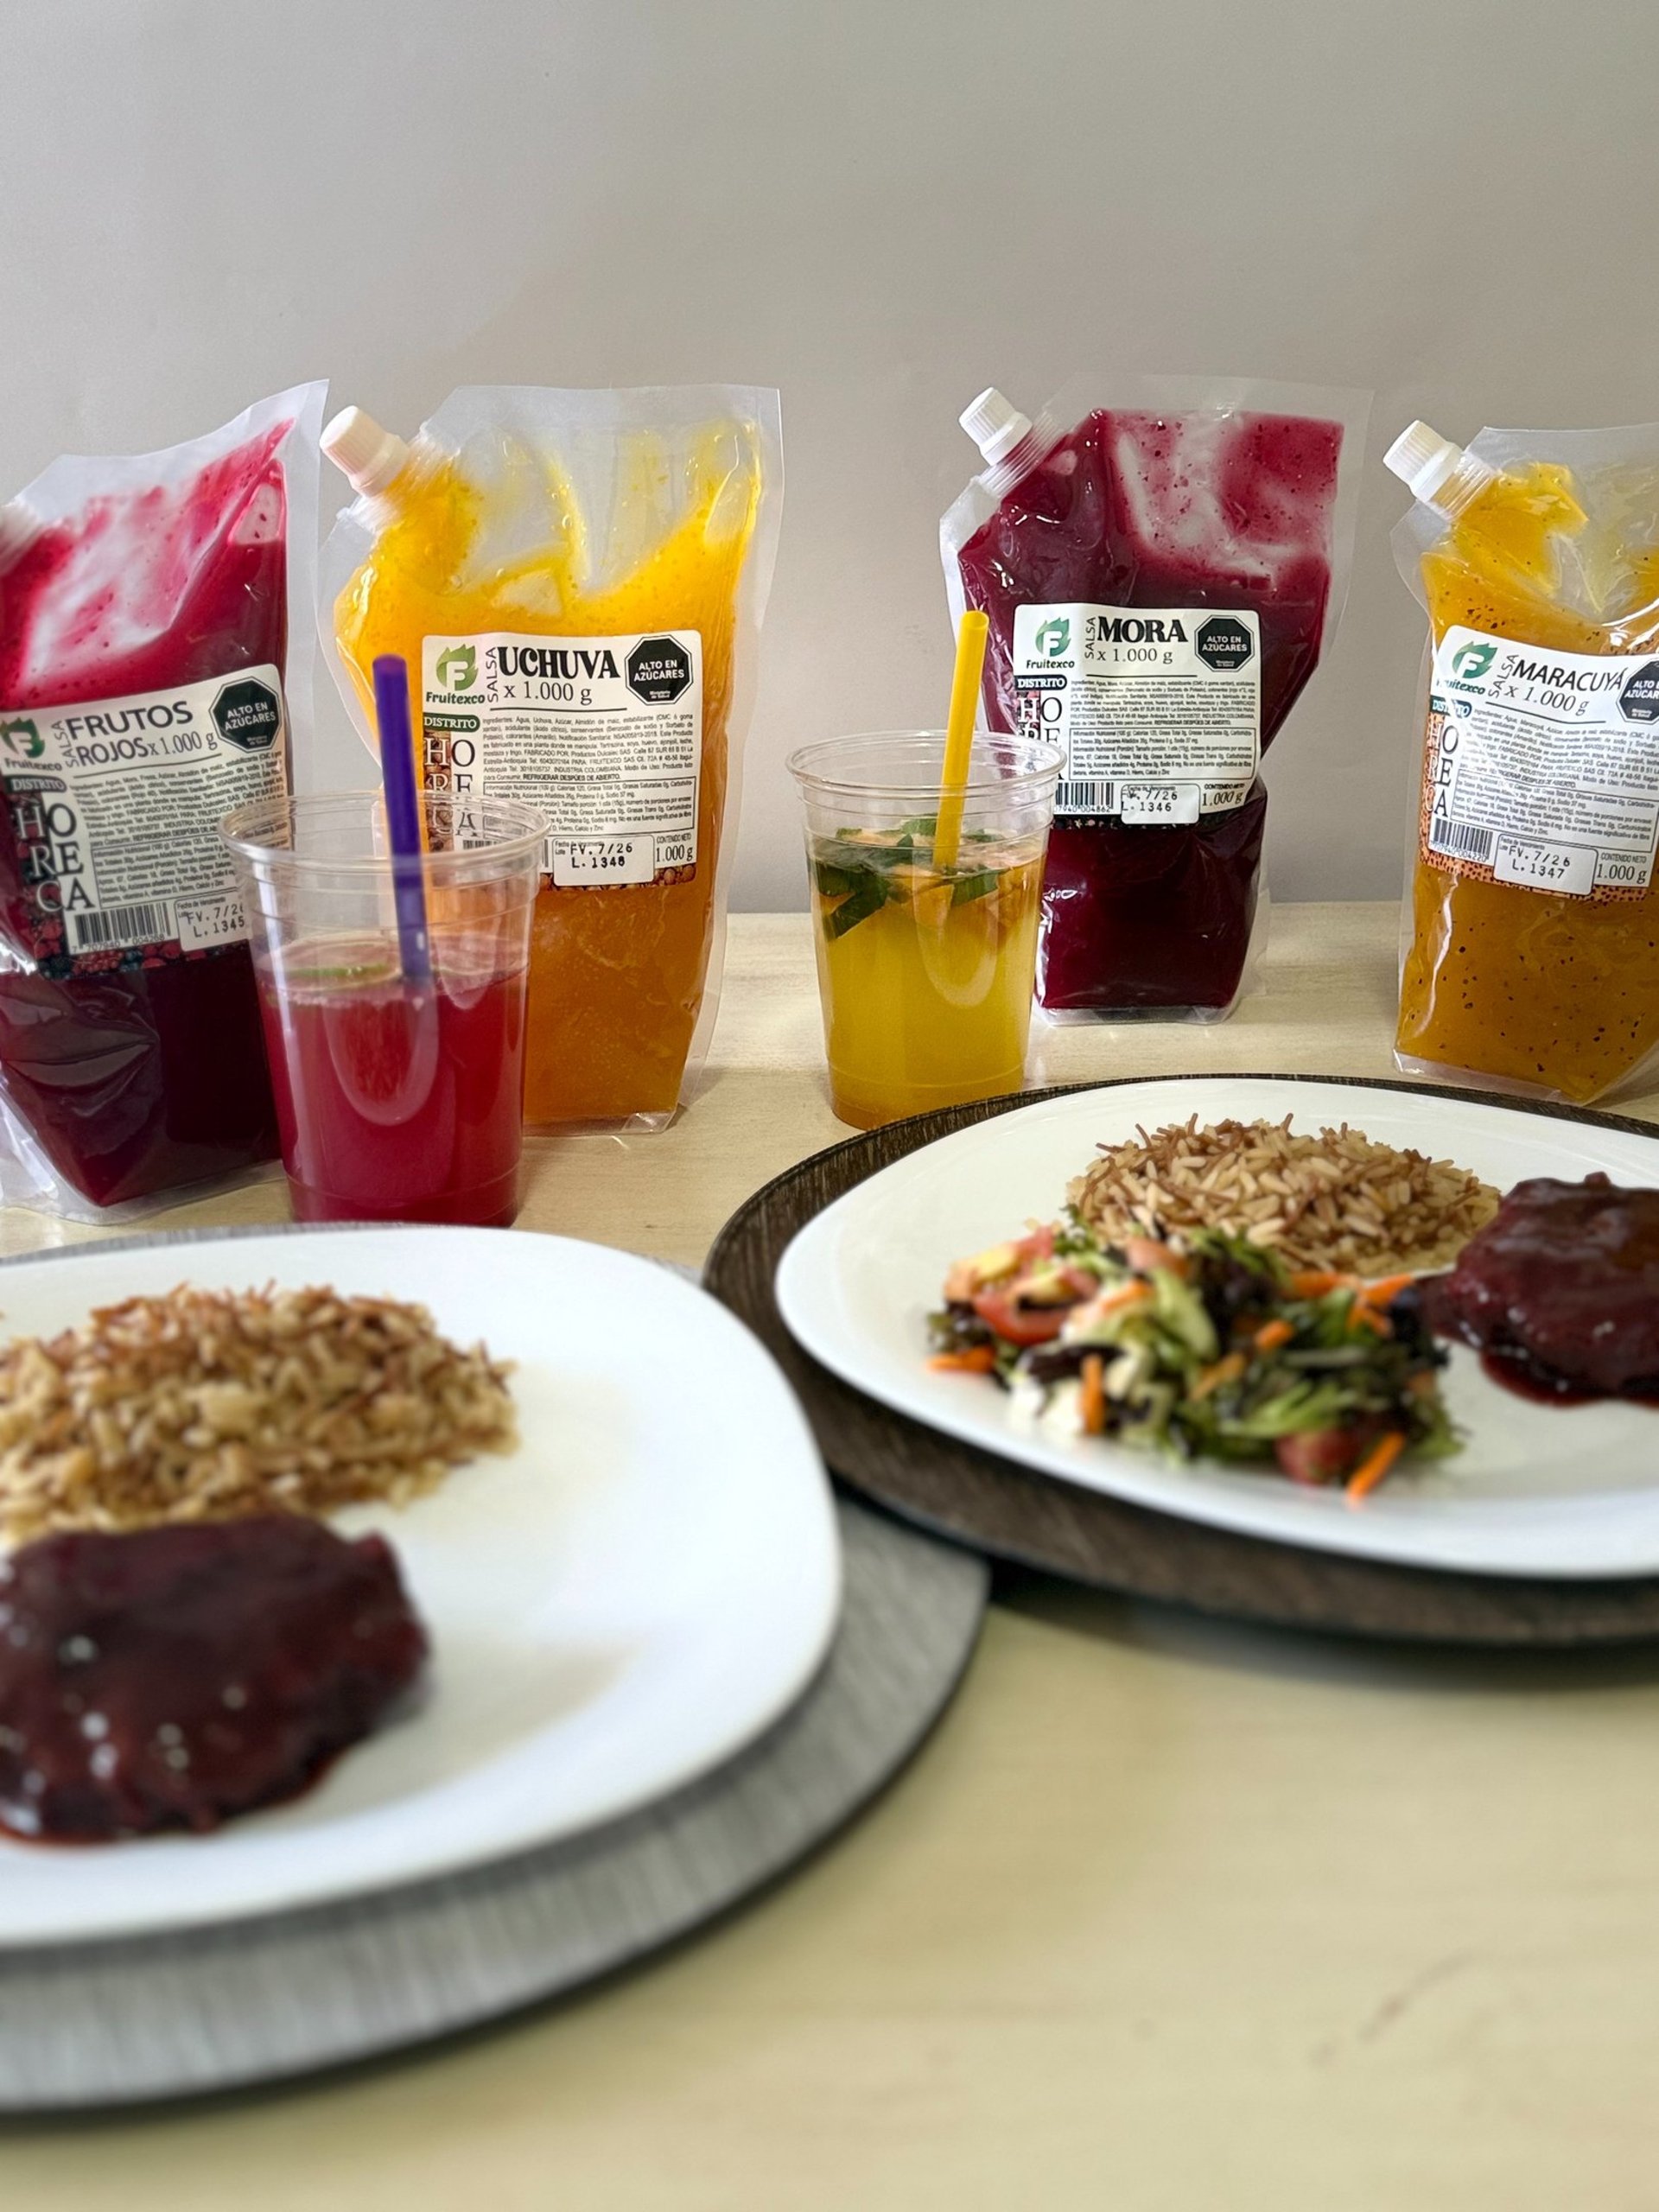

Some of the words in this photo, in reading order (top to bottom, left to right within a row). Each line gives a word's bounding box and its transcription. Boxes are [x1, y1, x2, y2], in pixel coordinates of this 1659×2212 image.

[1084, 617, 1096, 659] SALSA
[1097, 616, 1188, 643] MORA
[497, 646, 621, 679] UCHUVA
[639, 660, 663, 671] ALTO
[664, 659, 677, 669] EN
[1027, 659, 1075, 669] Fruitexco
[1097, 651, 1106, 661] x
[1114, 648, 1158, 662] 1.000
[1163, 652, 1173, 664] g
[486, 647, 499, 702] SALSA
[633, 669, 685, 682] AZÚCARES
[1018, 678, 1065, 688] DISTRITO
[1488, 654, 1519, 698] SALSA
[1512, 659, 1628, 691] MARACUYÁ
[504, 685, 516, 698] x
[524, 681, 574, 701] 1.000
[580, 688, 592, 705] g
[1633, 680, 1655, 689] ALTO
[426, 692, 485, 704] Fruitexco
[1503, 685, 1518, 697] x
[1523, 686, 1577, 712] 1.000
[1576, 699, 1589, 716] g
[227, 705, 253, 719] ALTO
[255, 702, 268, 711] EN
[65, 701, 193, 741] FRUTOS
[424, 717, 477, 728] DISTRITO
[52, 721, 80, 767] SALSA
[76, 737, 149, 766] ROJOS
[148, 742, 159, 756] x
[160, 731, 202, 755] 1.000
[206, 732, 218, 750] g
[5, 758, 62, 771] Fruitexco
[10, 778, 65, 791] DISTRITO
[1202, 791, 1235, 806] 1.000
[1235, 792, 1243, 804] g
[657, 844, 684, 862] 1.000
[686, 847, 693, 861] g
[1597, 863, 1635, 880] 1.000
[1637, 870, 1647, 885] g
